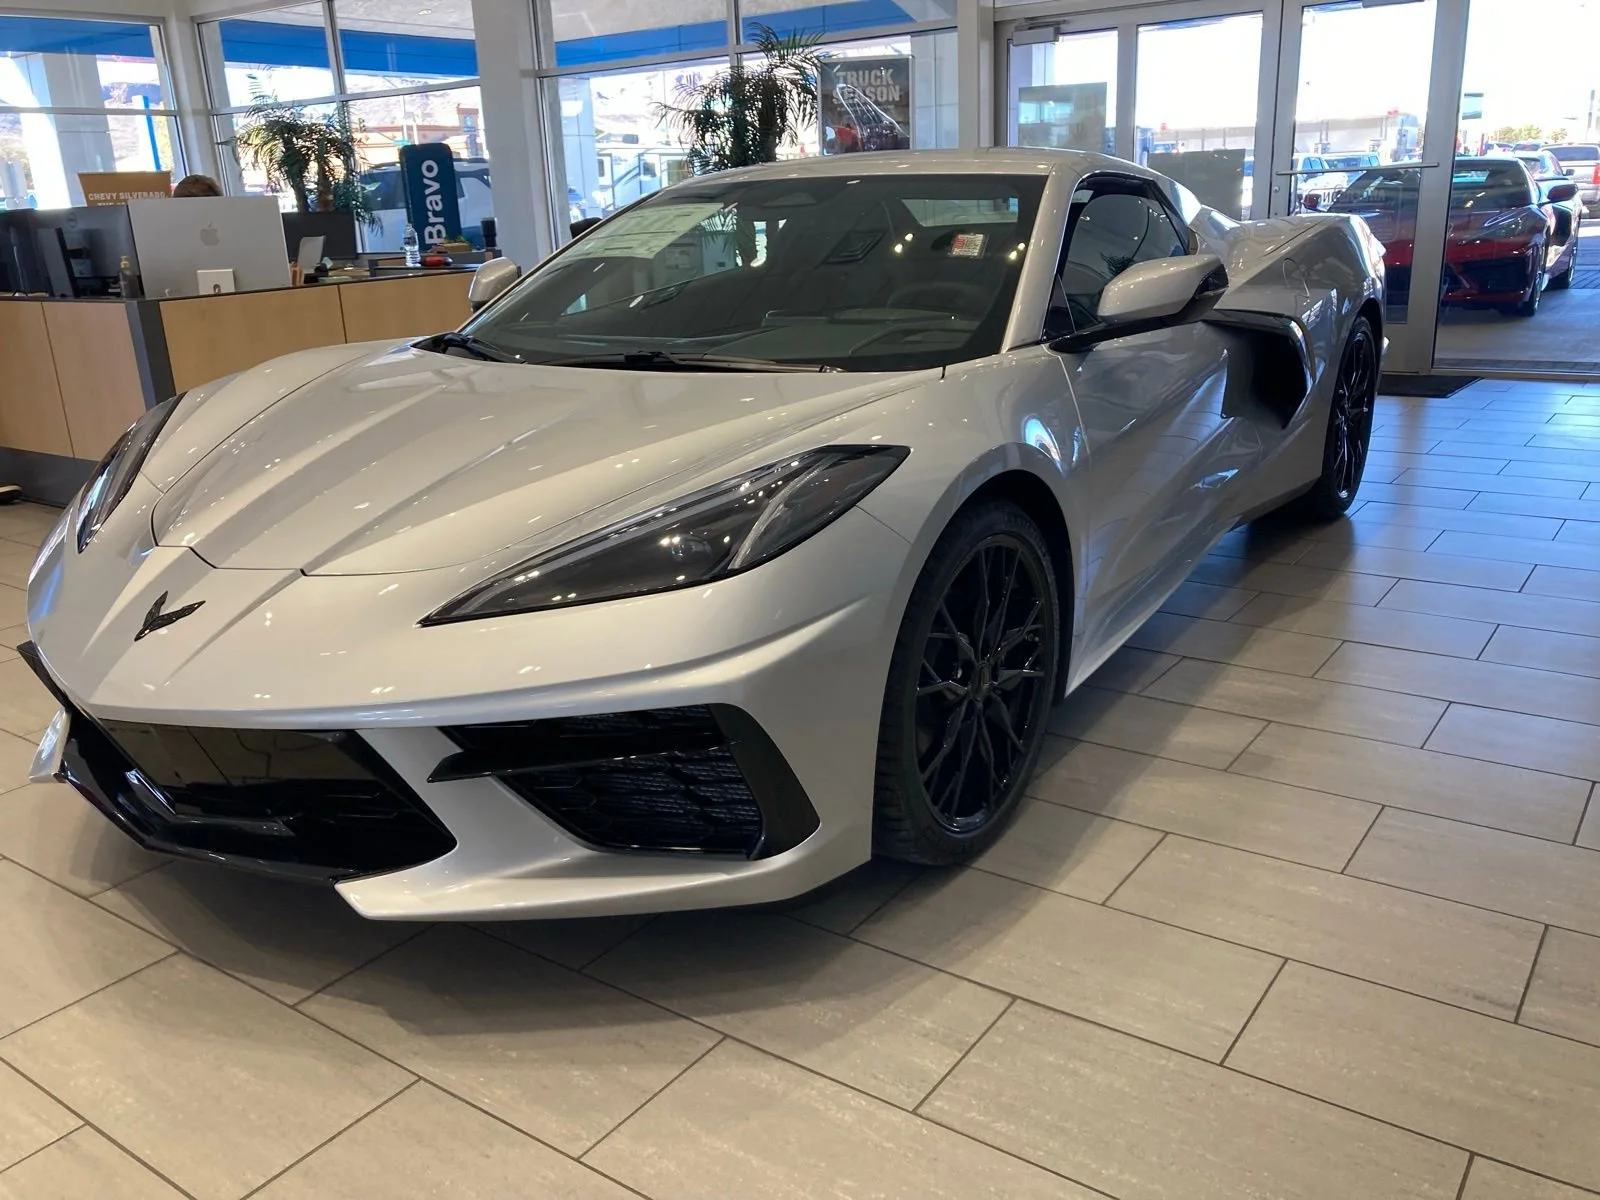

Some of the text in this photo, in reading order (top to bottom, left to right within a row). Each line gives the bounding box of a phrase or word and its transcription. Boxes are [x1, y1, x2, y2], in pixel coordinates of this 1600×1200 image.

[836, 69, 894, 86] TRUCK
[88, 192, 117, 201] CHEVY
[421, 159, 447, 245] Bravo
